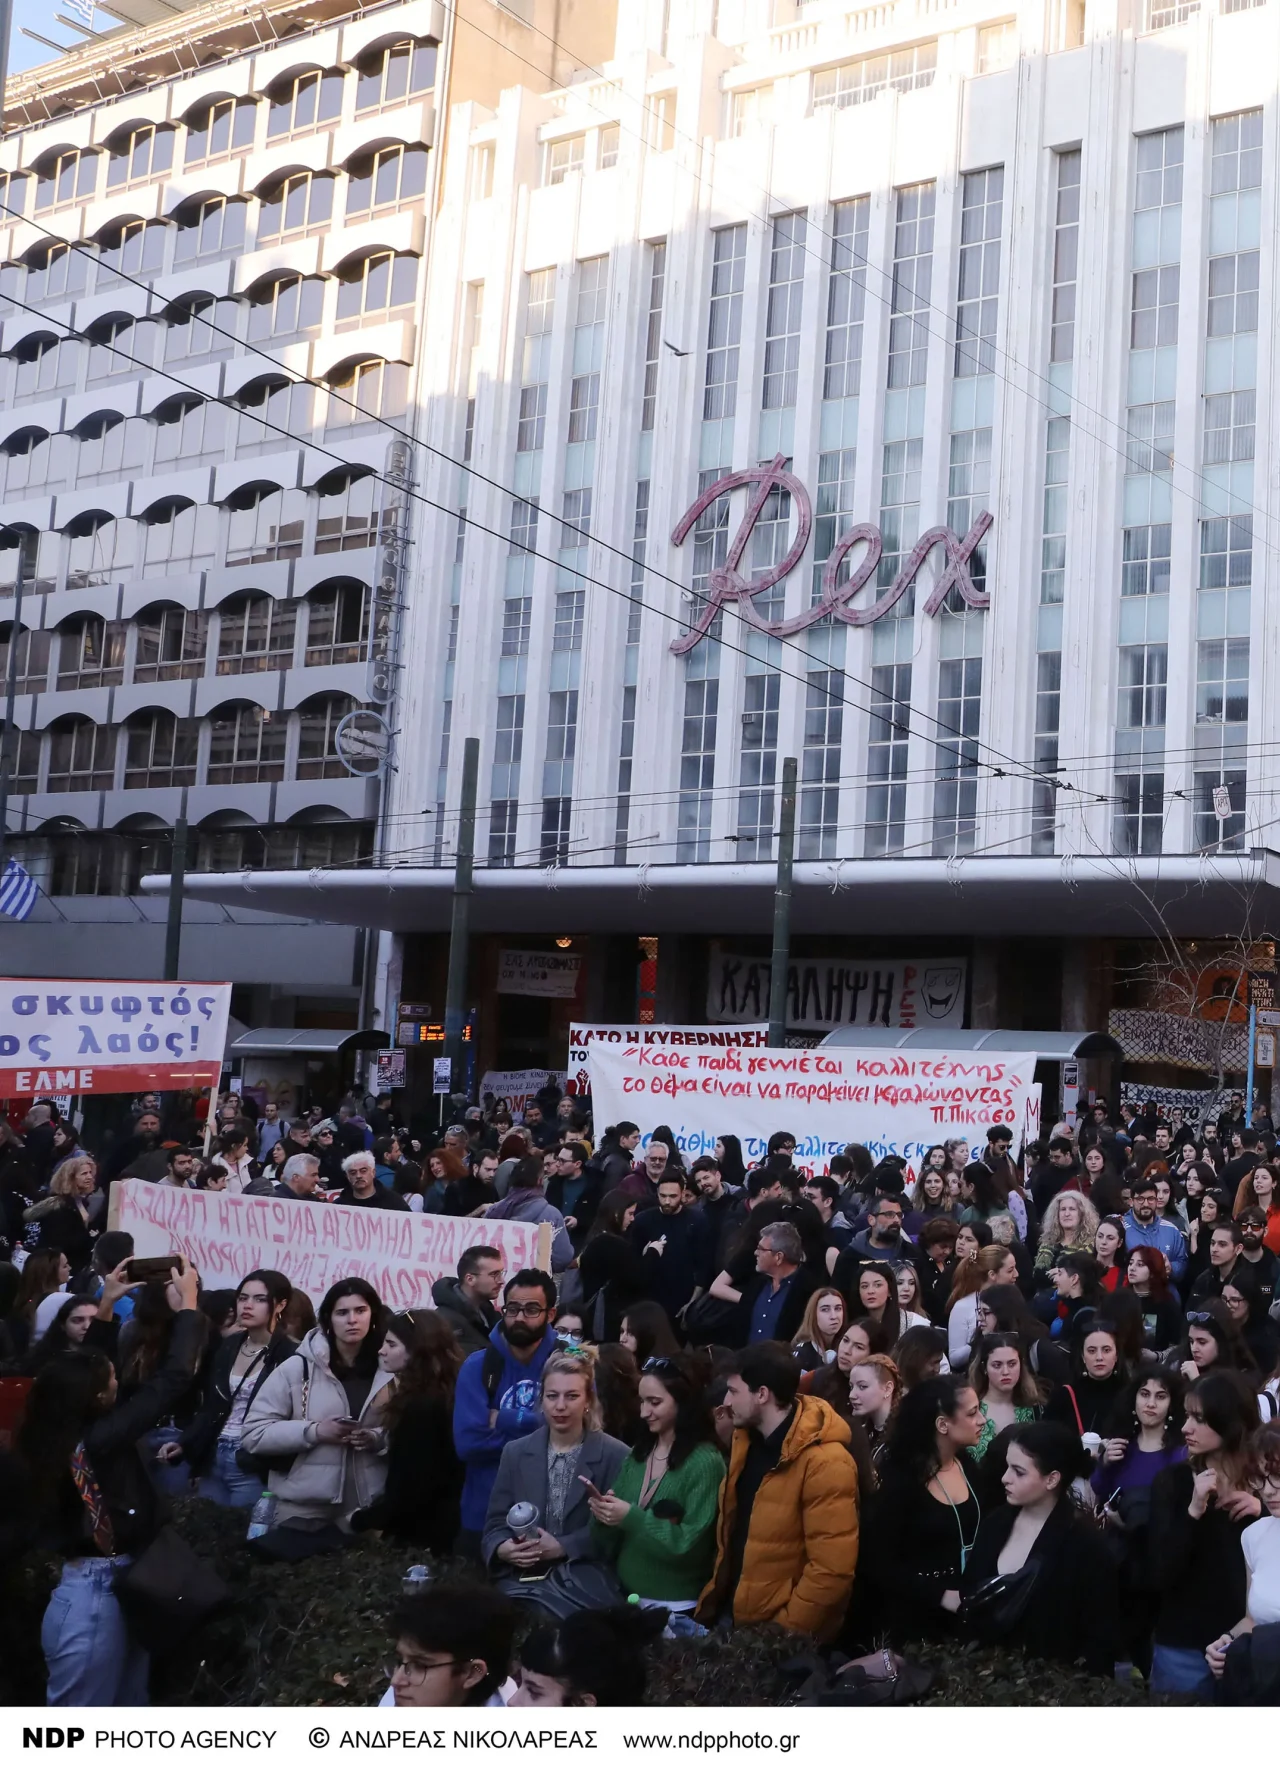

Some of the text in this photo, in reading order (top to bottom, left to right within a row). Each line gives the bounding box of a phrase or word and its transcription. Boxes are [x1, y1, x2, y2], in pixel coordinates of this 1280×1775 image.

[669, 452, 994, 655] Rex
[12, 987, 216, 1023] σκυφτός
[77, 1023, 200, 1058] λαός!
[626, 1031, 640, 1044] Η
[644, 1031, 769, 1047] ΚΥΒΕΡΝΗΣΗ
[571, 1051, 590, 1062] ΤΟ
[698, 1048, 742, 1072] παιδί
[857, 1055, 1006, 1083] καλλιτέχνης
[16, 1069, 93, 1092] ΕΛΜΕ
[623, 1076, 645, 1093] το
[651, 1072, 697, 1099] θέμα
[702, 1073, 751, 1098] είναι
[757, 1082, 781, 1099] να
[785, 1080, 869, 1104] παραμείνει
[745, 1138, 769, 1156] τη
